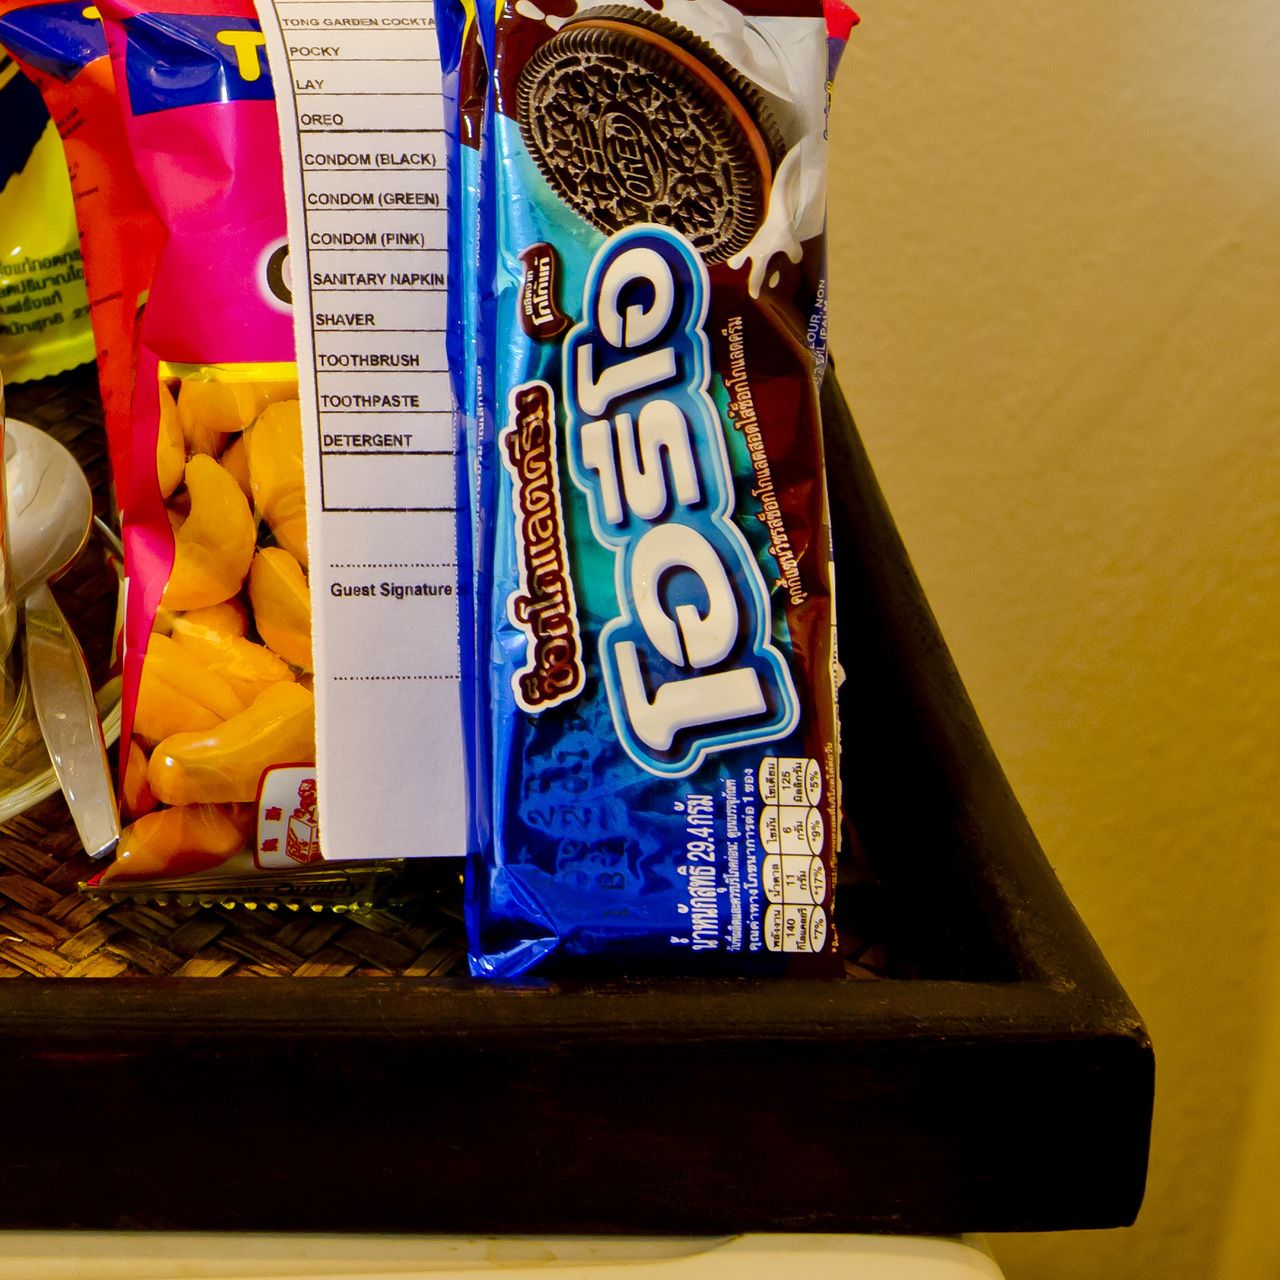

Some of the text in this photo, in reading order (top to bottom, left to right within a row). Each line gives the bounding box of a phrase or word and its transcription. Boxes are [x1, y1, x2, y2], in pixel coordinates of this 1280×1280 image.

[282, 17, 379, 27] TONG GARDEN
[290, 46, 341, 57] POCKY
[296, 79, 325, 91] LAY
[300, 114, 344, 126] OREO
[304, 152, 437, 167] CONDOM (BLACK)
[307, 192, 440, 207] CONDOM (GREEN)
[310, 232, 425, 248] CONDOM (PINK)
[313, 273, 445, 285] SANITARY NAPKIN
[532, 256, 554, 326] โกโก้แท้
[315, 313, 376, 326] SHAVER
[318, 354, 420, 367] TOOTHBRUSH
[320, 394, 420, 407] TOOTHPASTE
[323, 433, 413, 447] DETERGENT
[577, 247, 768, 751] โอรีโอ
[508, 388, 576, 705] ช็อกโกแลตครีม
[330, 581, 453, 600] Guest Signature
[764, 762, 777, 801] โซเดียม
[781, 770, 791, 791] 125
[793, 761, 804, 803] มิลลิกรัม
[782, 826, 792, 834] 6
[793, 820, 805, 841] กรัม
[670, 794, 727, 951] น้ำหนักสุทธิ 29.4 กรัม
[742, 806, 763, 951] คุณค่าทางโภชนาการต่อ
[767, 863, 782, 898] น้ำตาล
[785, 874, 795, 887] 11
[795, 869, 807, 891] กรัม
[768, 909, 782, 949] พลังงาน
[786, 918, 796, 939] 140
